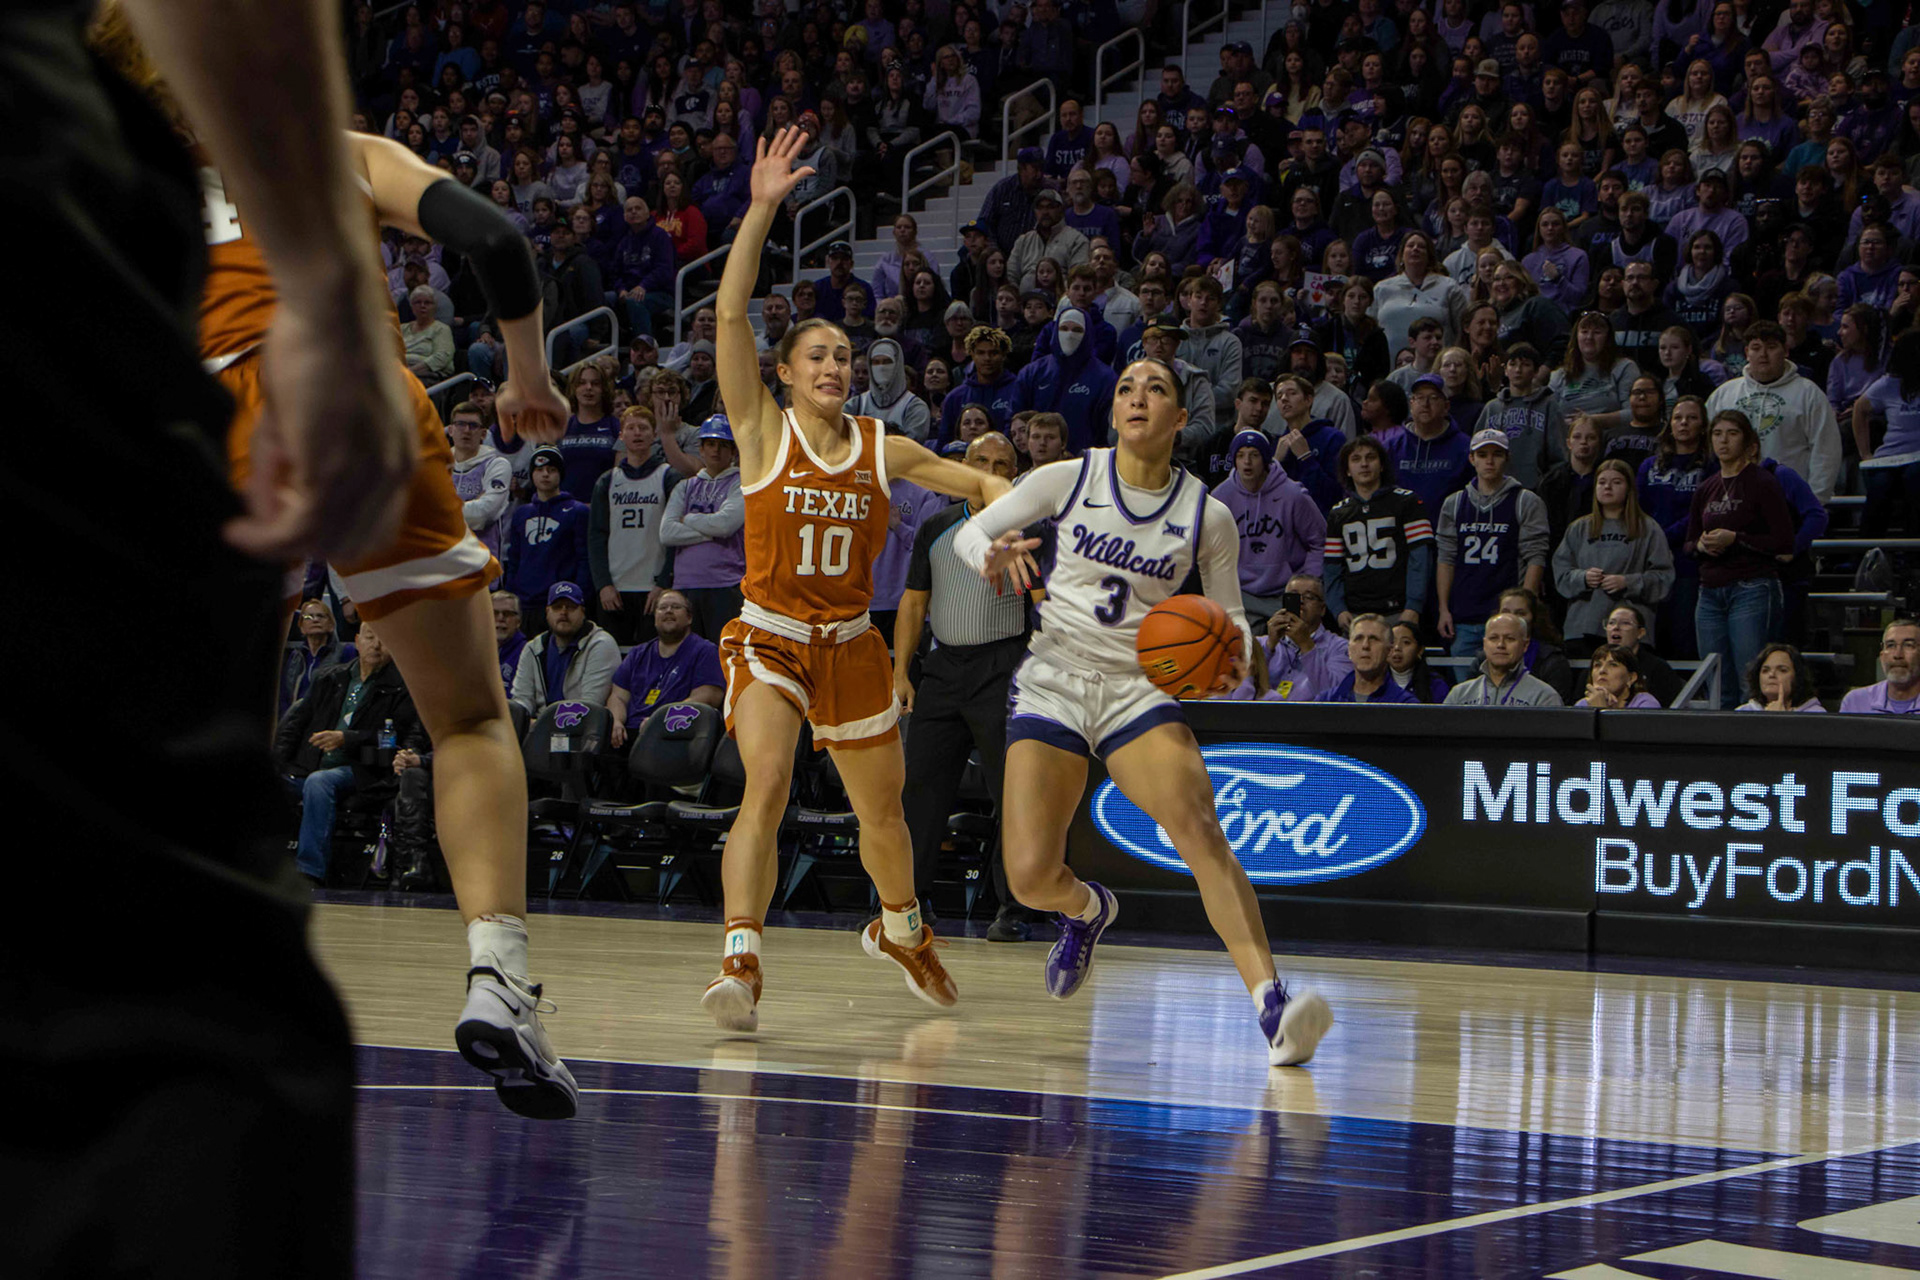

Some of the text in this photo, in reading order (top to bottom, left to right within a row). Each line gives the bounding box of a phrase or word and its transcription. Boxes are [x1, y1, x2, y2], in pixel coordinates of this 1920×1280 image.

[562, 437, 608, 446] WILDCATS
[612, 491, 659, 505] Wildcats
[783, 485, 871, 521] TEXAS
[622, 509, 645, 528] 21
[1459, 522, 1510, 534] K-STATE
[796, 523, 854, 576] 10
[1073, 524, 1177, 581] Wildcats
[1342, 516, 1397, 573] 95
[1464, 535, 1500, 565] 24
[1094, 575, 1131, 627] 3
[1462, 760, 1920, 838] Midwest Fo
[550, 850, 565, 861] 26
[660, 854, 675, 865] 27
[965, 869, 980, 880] 30
[1595, 836, 1920, 908] BuyFordN
